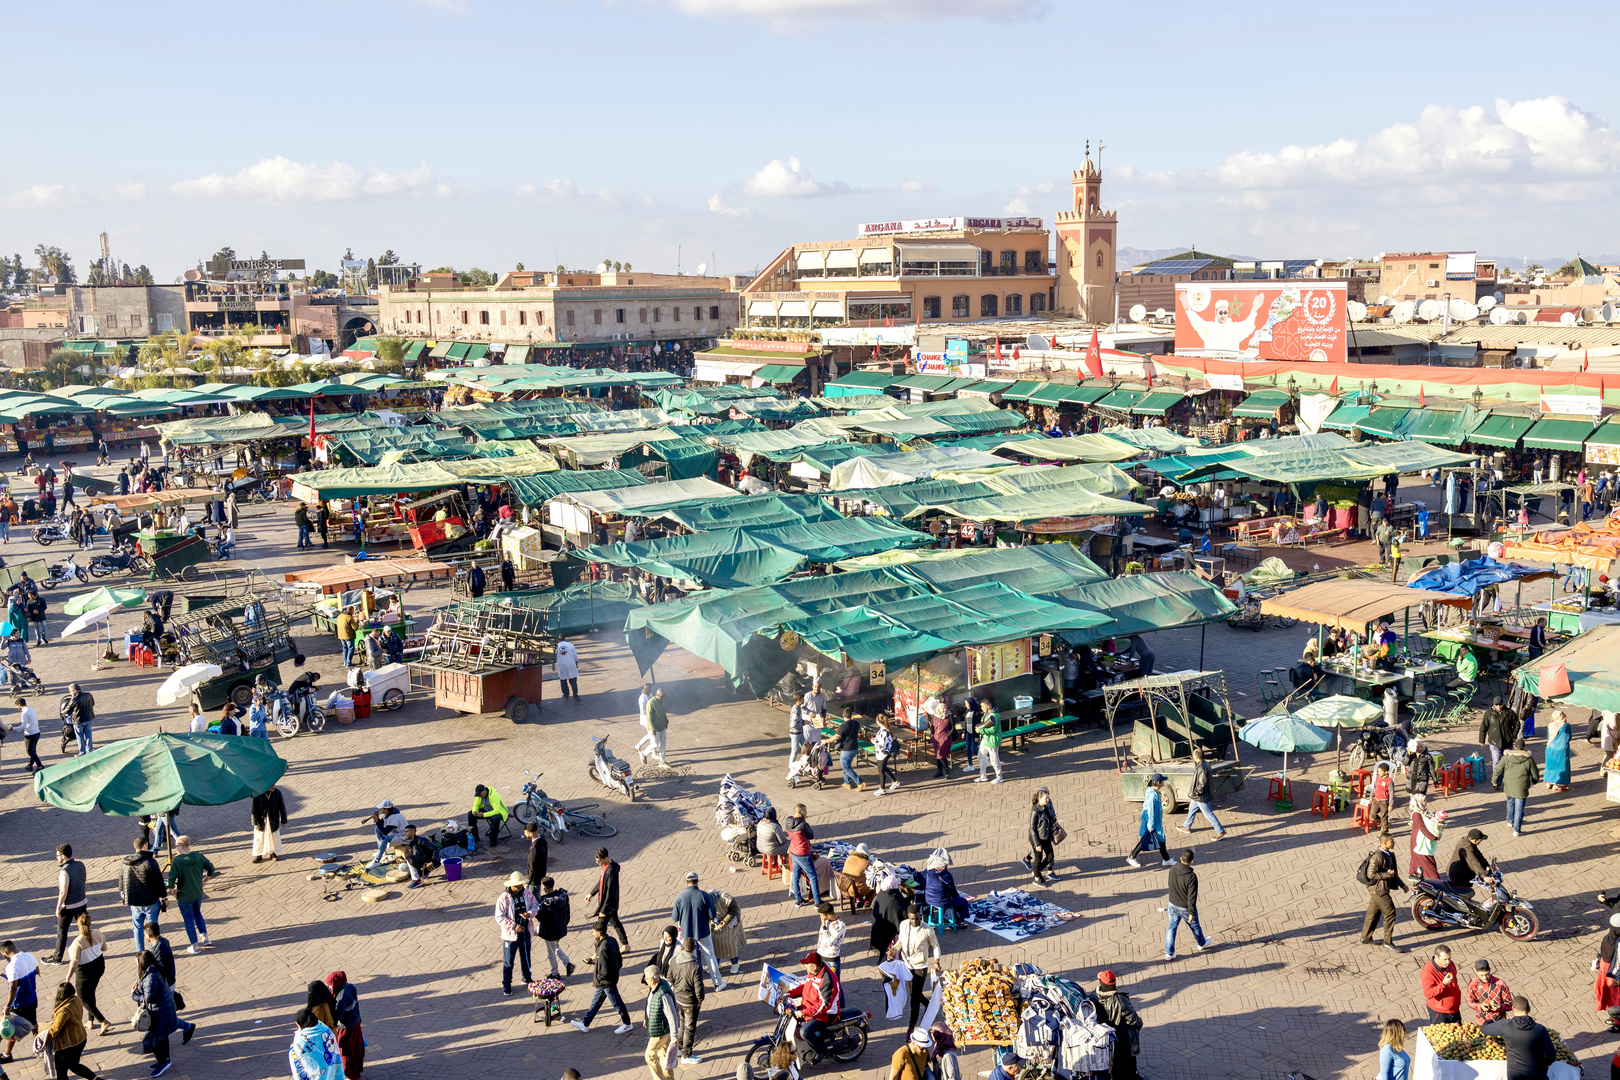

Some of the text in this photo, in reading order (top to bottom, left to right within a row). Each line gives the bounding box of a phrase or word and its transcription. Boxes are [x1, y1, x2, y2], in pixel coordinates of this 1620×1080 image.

[864, 222, 903, 233] ARGANA
[966, 218, 1002, 228] ARGANA
[1312, 297, 1327, 308] 20
[918, 361, 946, 372] EXCHANGE
[962, 526, 974, 535] 42
[984, 526, 994, 536] 42
[1040, 641, 1051, 650] 34
[872, 670, 884, 679] 34
